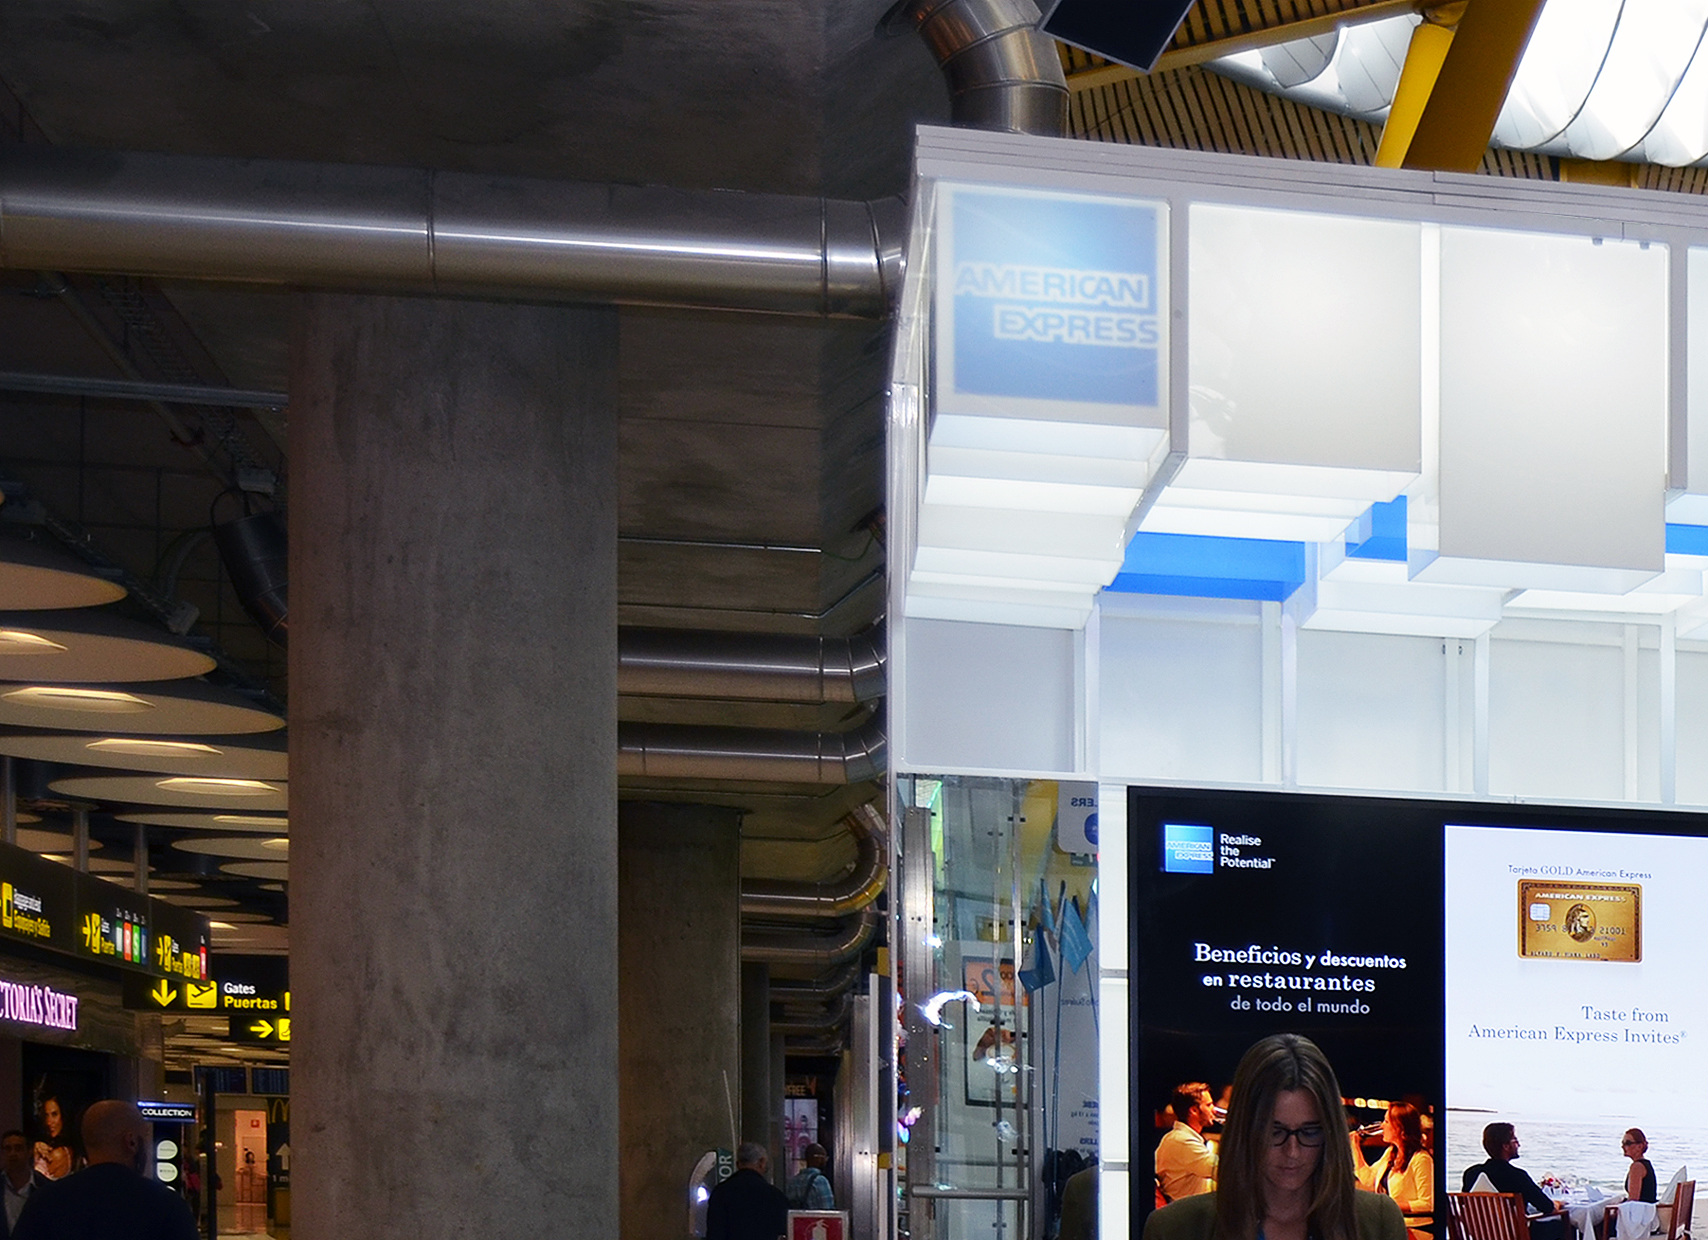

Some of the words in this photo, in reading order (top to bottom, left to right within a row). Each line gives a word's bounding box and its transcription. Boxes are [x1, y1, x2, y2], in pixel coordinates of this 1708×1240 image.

[954, 264, 1147, 306] AMERICAN
[996, 307, 1160, 347] EXPRESS
[1166, 841, 1212, 851] AMERICAN
[1220, 833, 1262, 846] Realise
[1175, 851, 1214, 861] EXPRESS
[1220, 846, 1240, 856] the
[1508, 865, 1538, 877] Tarjeta
[1540, 866, 1573, 876] GOLD
[1576, 868, 1617, 878] American
[1619, 869, 1652, 880] Express
[1535, 892, 1584, 901] AMERICAN
[1194, 943, 1301, 966] Beneficios
[1305, 955, 1316, 970] y
[1320, 952, 1407, 970] descuentos
[223, 982, 256, 995] Gates
[1203, 975, 1223, 988] en
[1228, 972, 1376, 993] restaurantes
[224, 995, 278, 1010] Puertas
[1231, 996, 1251, 1011] de
[1255, 996, 1293, 1012] todo
[1297, 997, 1312, 1013] el
[1317, 999, 1370, 1015] mundo
[1581, 1005, 1627, 1022] Taste
[1631, 1007, 1669, 1022] from
[1468, 1024, 1548, 1040] American
[1554, 1026, 1619, 1044] Express
[141, 1108, 193, 1117] COLLECTION
